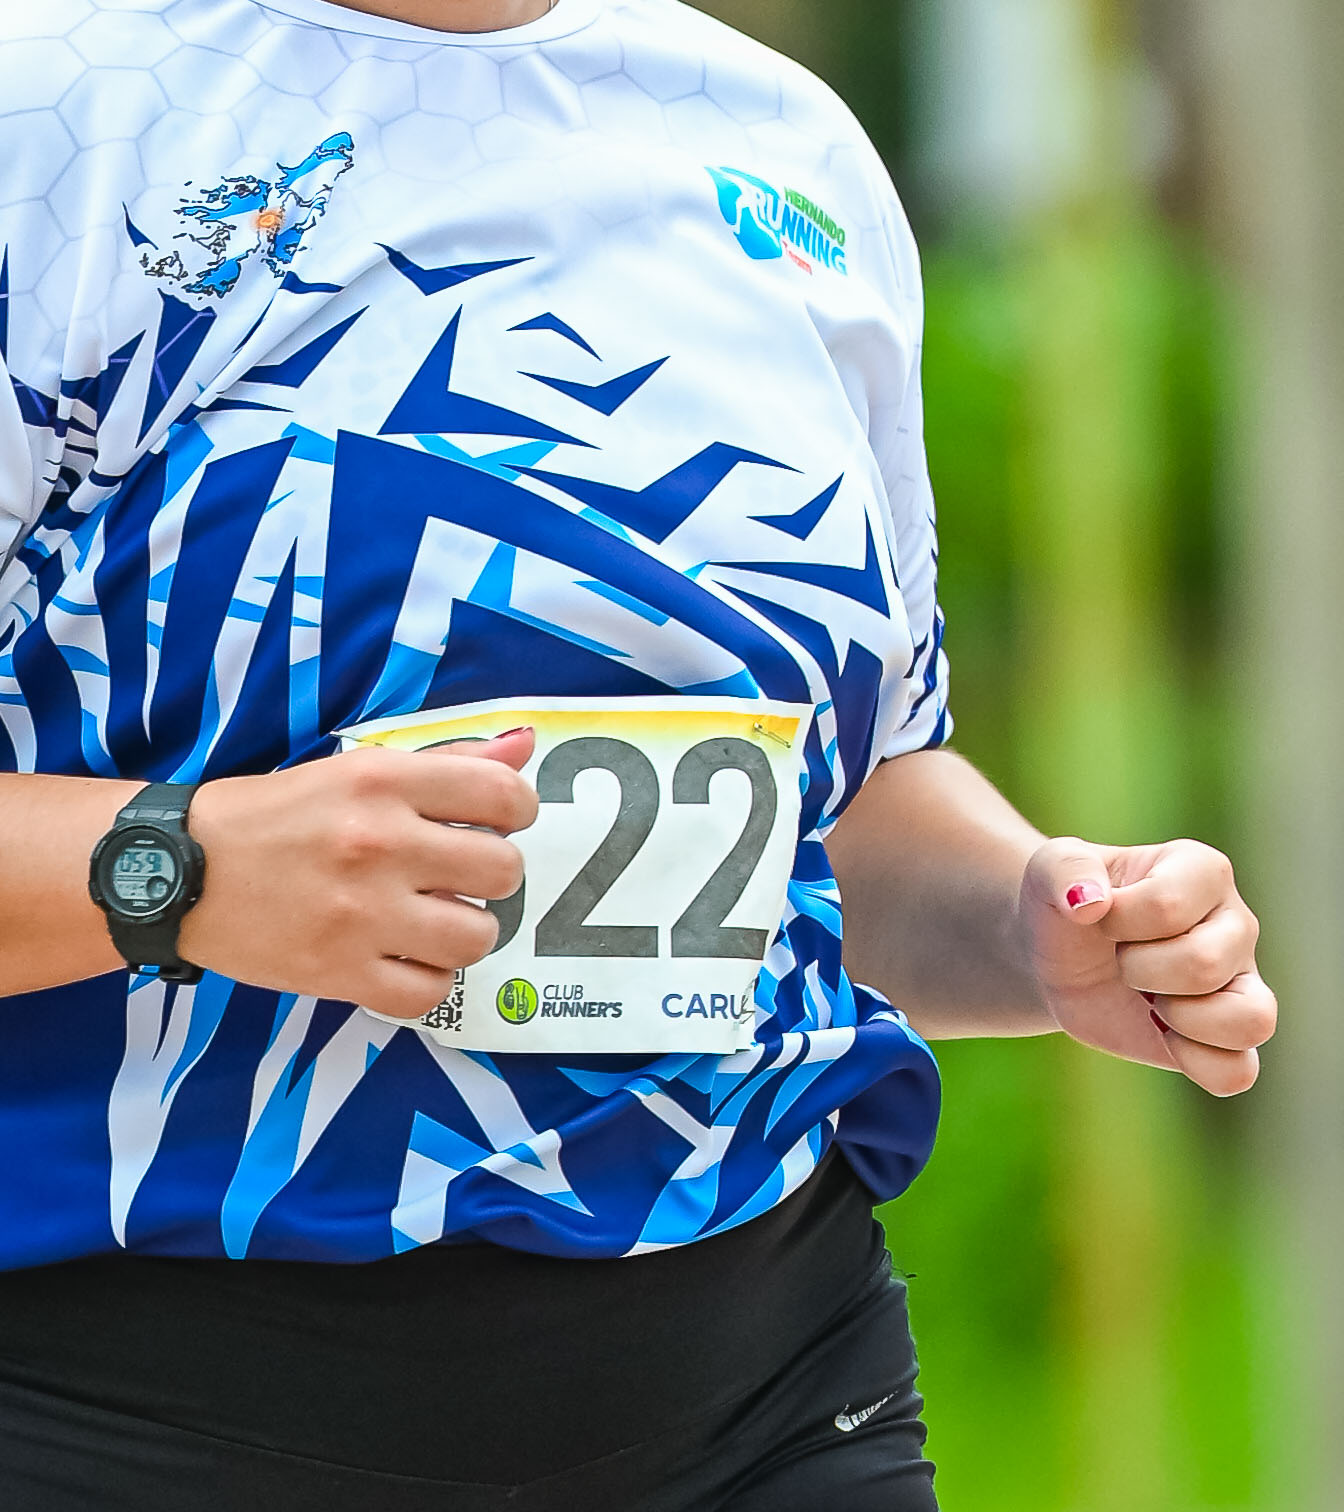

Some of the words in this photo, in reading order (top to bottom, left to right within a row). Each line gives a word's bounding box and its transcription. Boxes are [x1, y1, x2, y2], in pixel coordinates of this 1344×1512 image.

[750, 188, 849, 276] RUNNING
[783, 185, 846, 247] HERNANDO
[413, 736, 778, 961] 22
[540, 1001, 623, 1018] RUNNER'S
[543, 984, 584, 1000] CLUB
